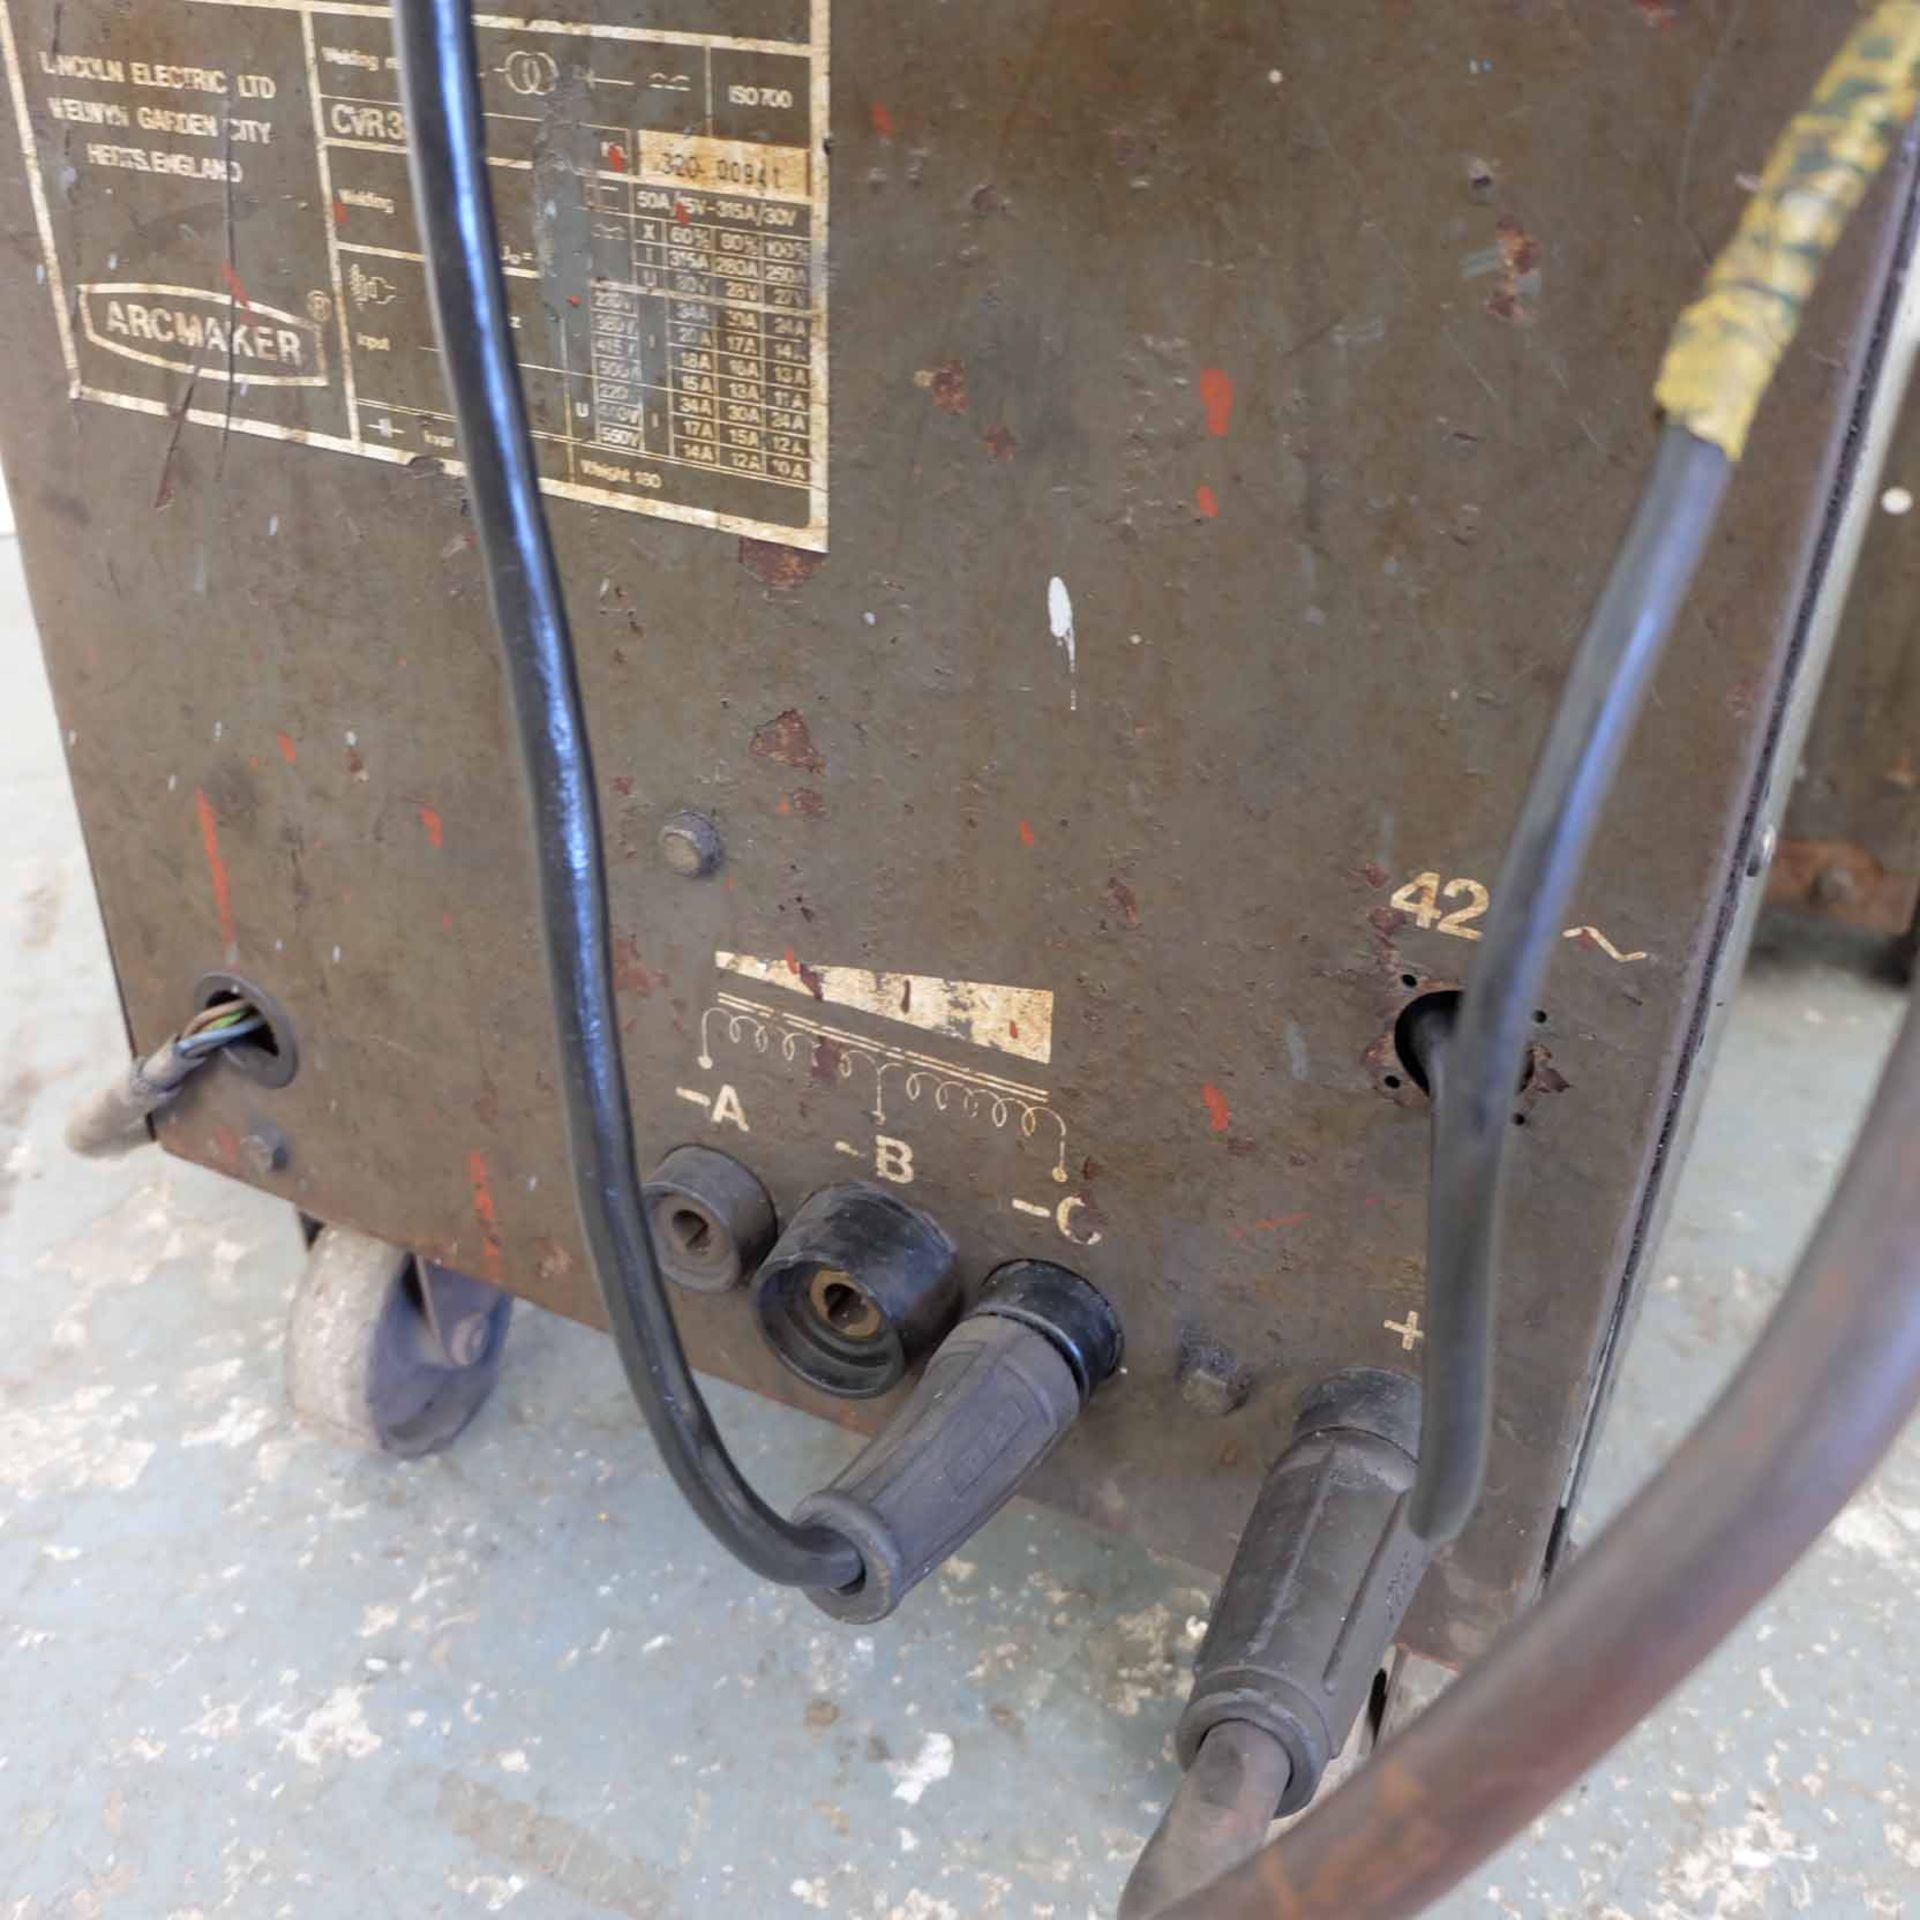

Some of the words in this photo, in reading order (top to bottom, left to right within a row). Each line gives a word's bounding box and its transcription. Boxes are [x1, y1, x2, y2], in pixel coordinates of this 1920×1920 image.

[39, 51, 125, 83] LNCOLN
[130, 62, 228, 94] ELECTRIC
[237, 74, 276, 99] LTD
[729, 85, 758, 107] ISO
[759, 88, 792, 108] 700
[137, 106, 218, 137] GARDEN
[222, 117, 271, 144] CITY
[642, 223, 655, 241] X
[670, 227, 710, 249] 60%
[720, 233, 759, 256] 80%
[717, 256, 758, 278] 280A
[106, 300, 301, 366] ARCMAKER
[775, 317, 806, 337] 24A
[727, 336, 757, 354] 17A
[681, 352, 711, 370] 18A
[681, 375, 713, 393] 15A
[729, 382, 760, 400] 13A
[575, 402, 589, 418] U
[680, 397, 712, 415] 34A
[727, 405, 760, 423] 30A
[771, 412, 806, 431] 24A
[683, 421, 713, 439] 17A
[729, 428, 760, 447] 15A
[773, 437, 806, 456] 12A
[731, 452, 761, 470] 12A
[772, 459, 806, 479] 10A
